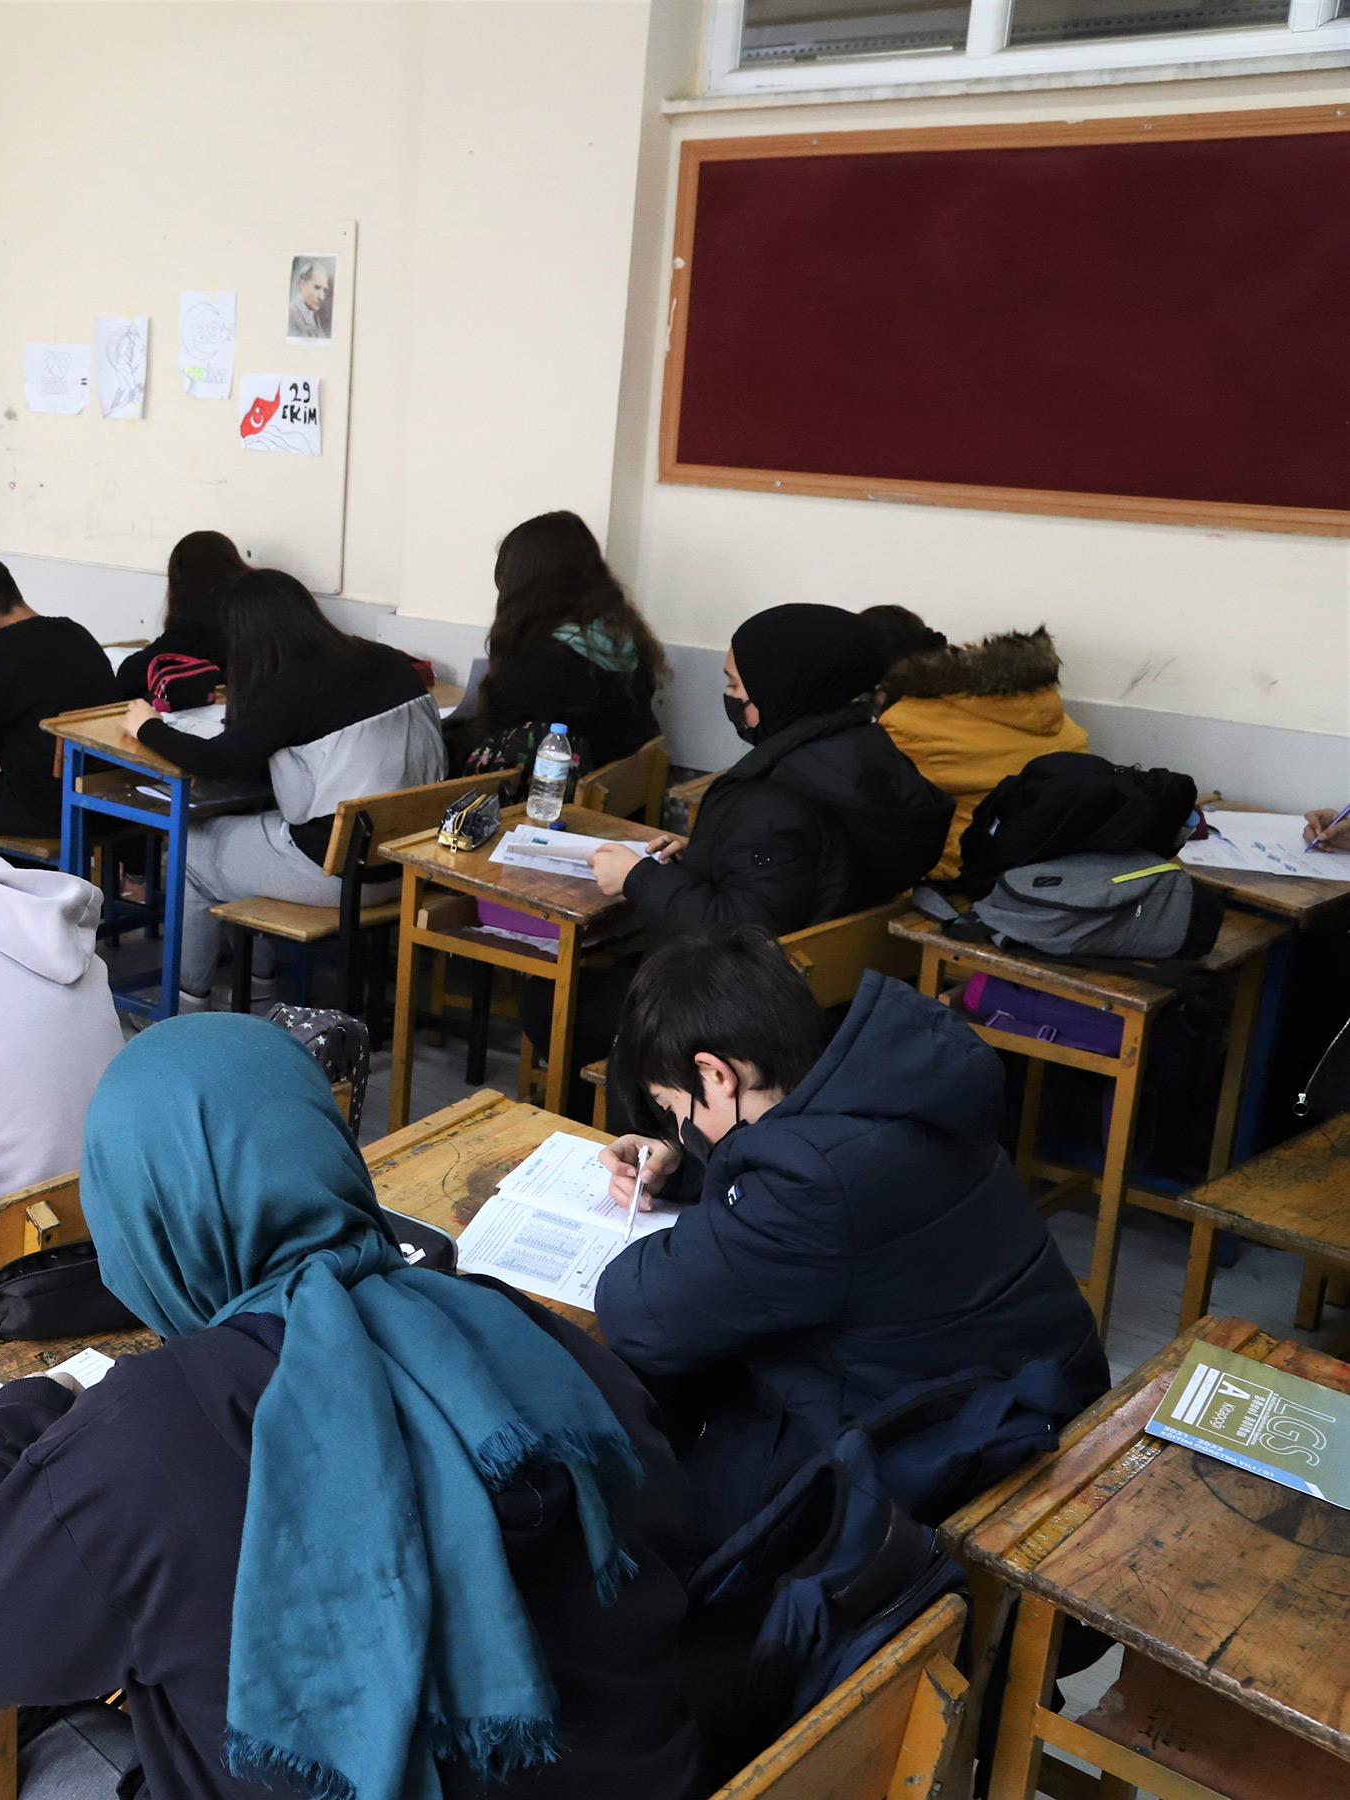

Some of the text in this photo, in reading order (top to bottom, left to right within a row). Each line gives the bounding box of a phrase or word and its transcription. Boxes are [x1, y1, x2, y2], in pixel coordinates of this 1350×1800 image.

[289, 381, 311, 403] 29
[282, 404, 317, 425] EKİM
[1218, 1380, 1251, 1400] A
[1162, 1425, 1188, 1439] 2021
[1196, 1438, 1224, 1452] 2022
[1259, 1397, 1336, 1467] LGS
[1262, 1470, 1275, 1478] 01
